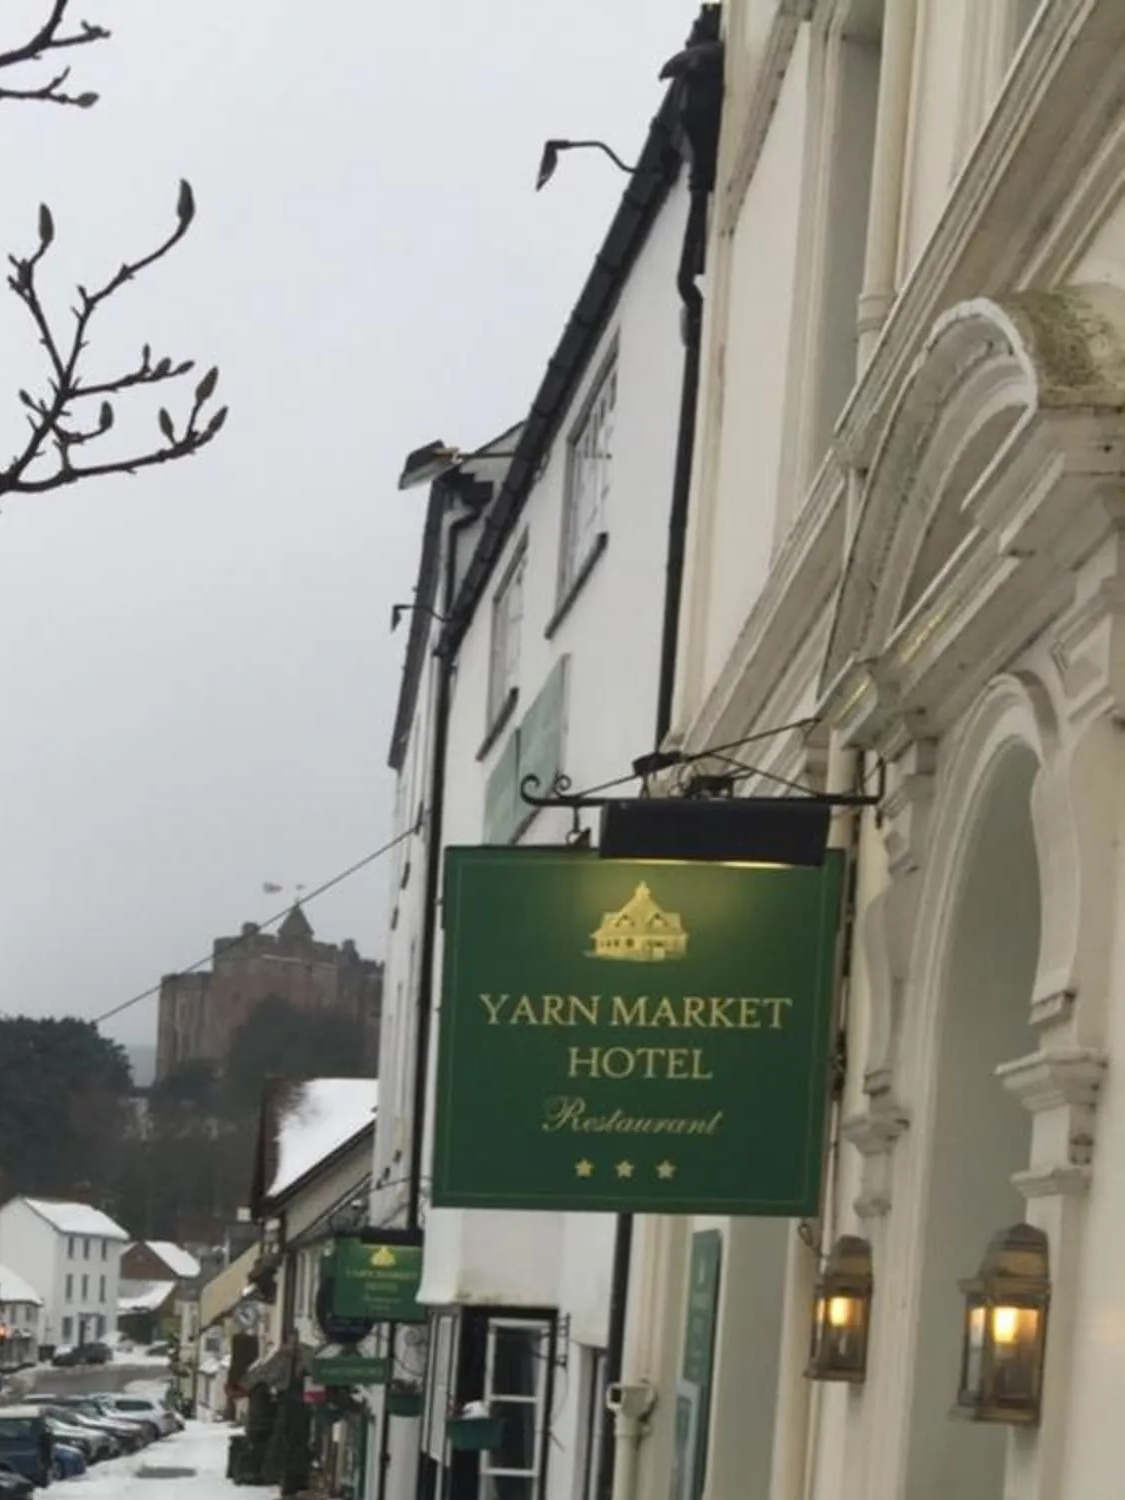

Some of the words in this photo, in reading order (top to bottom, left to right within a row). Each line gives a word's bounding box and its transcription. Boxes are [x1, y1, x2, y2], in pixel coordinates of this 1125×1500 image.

[479, 994, 600, 1025] YARN
[610, 995, 793, 1029] MARKET
[568, 1047, 713, 1080] HOTEL
[541, 1096, 724, 1135] Restaurant
